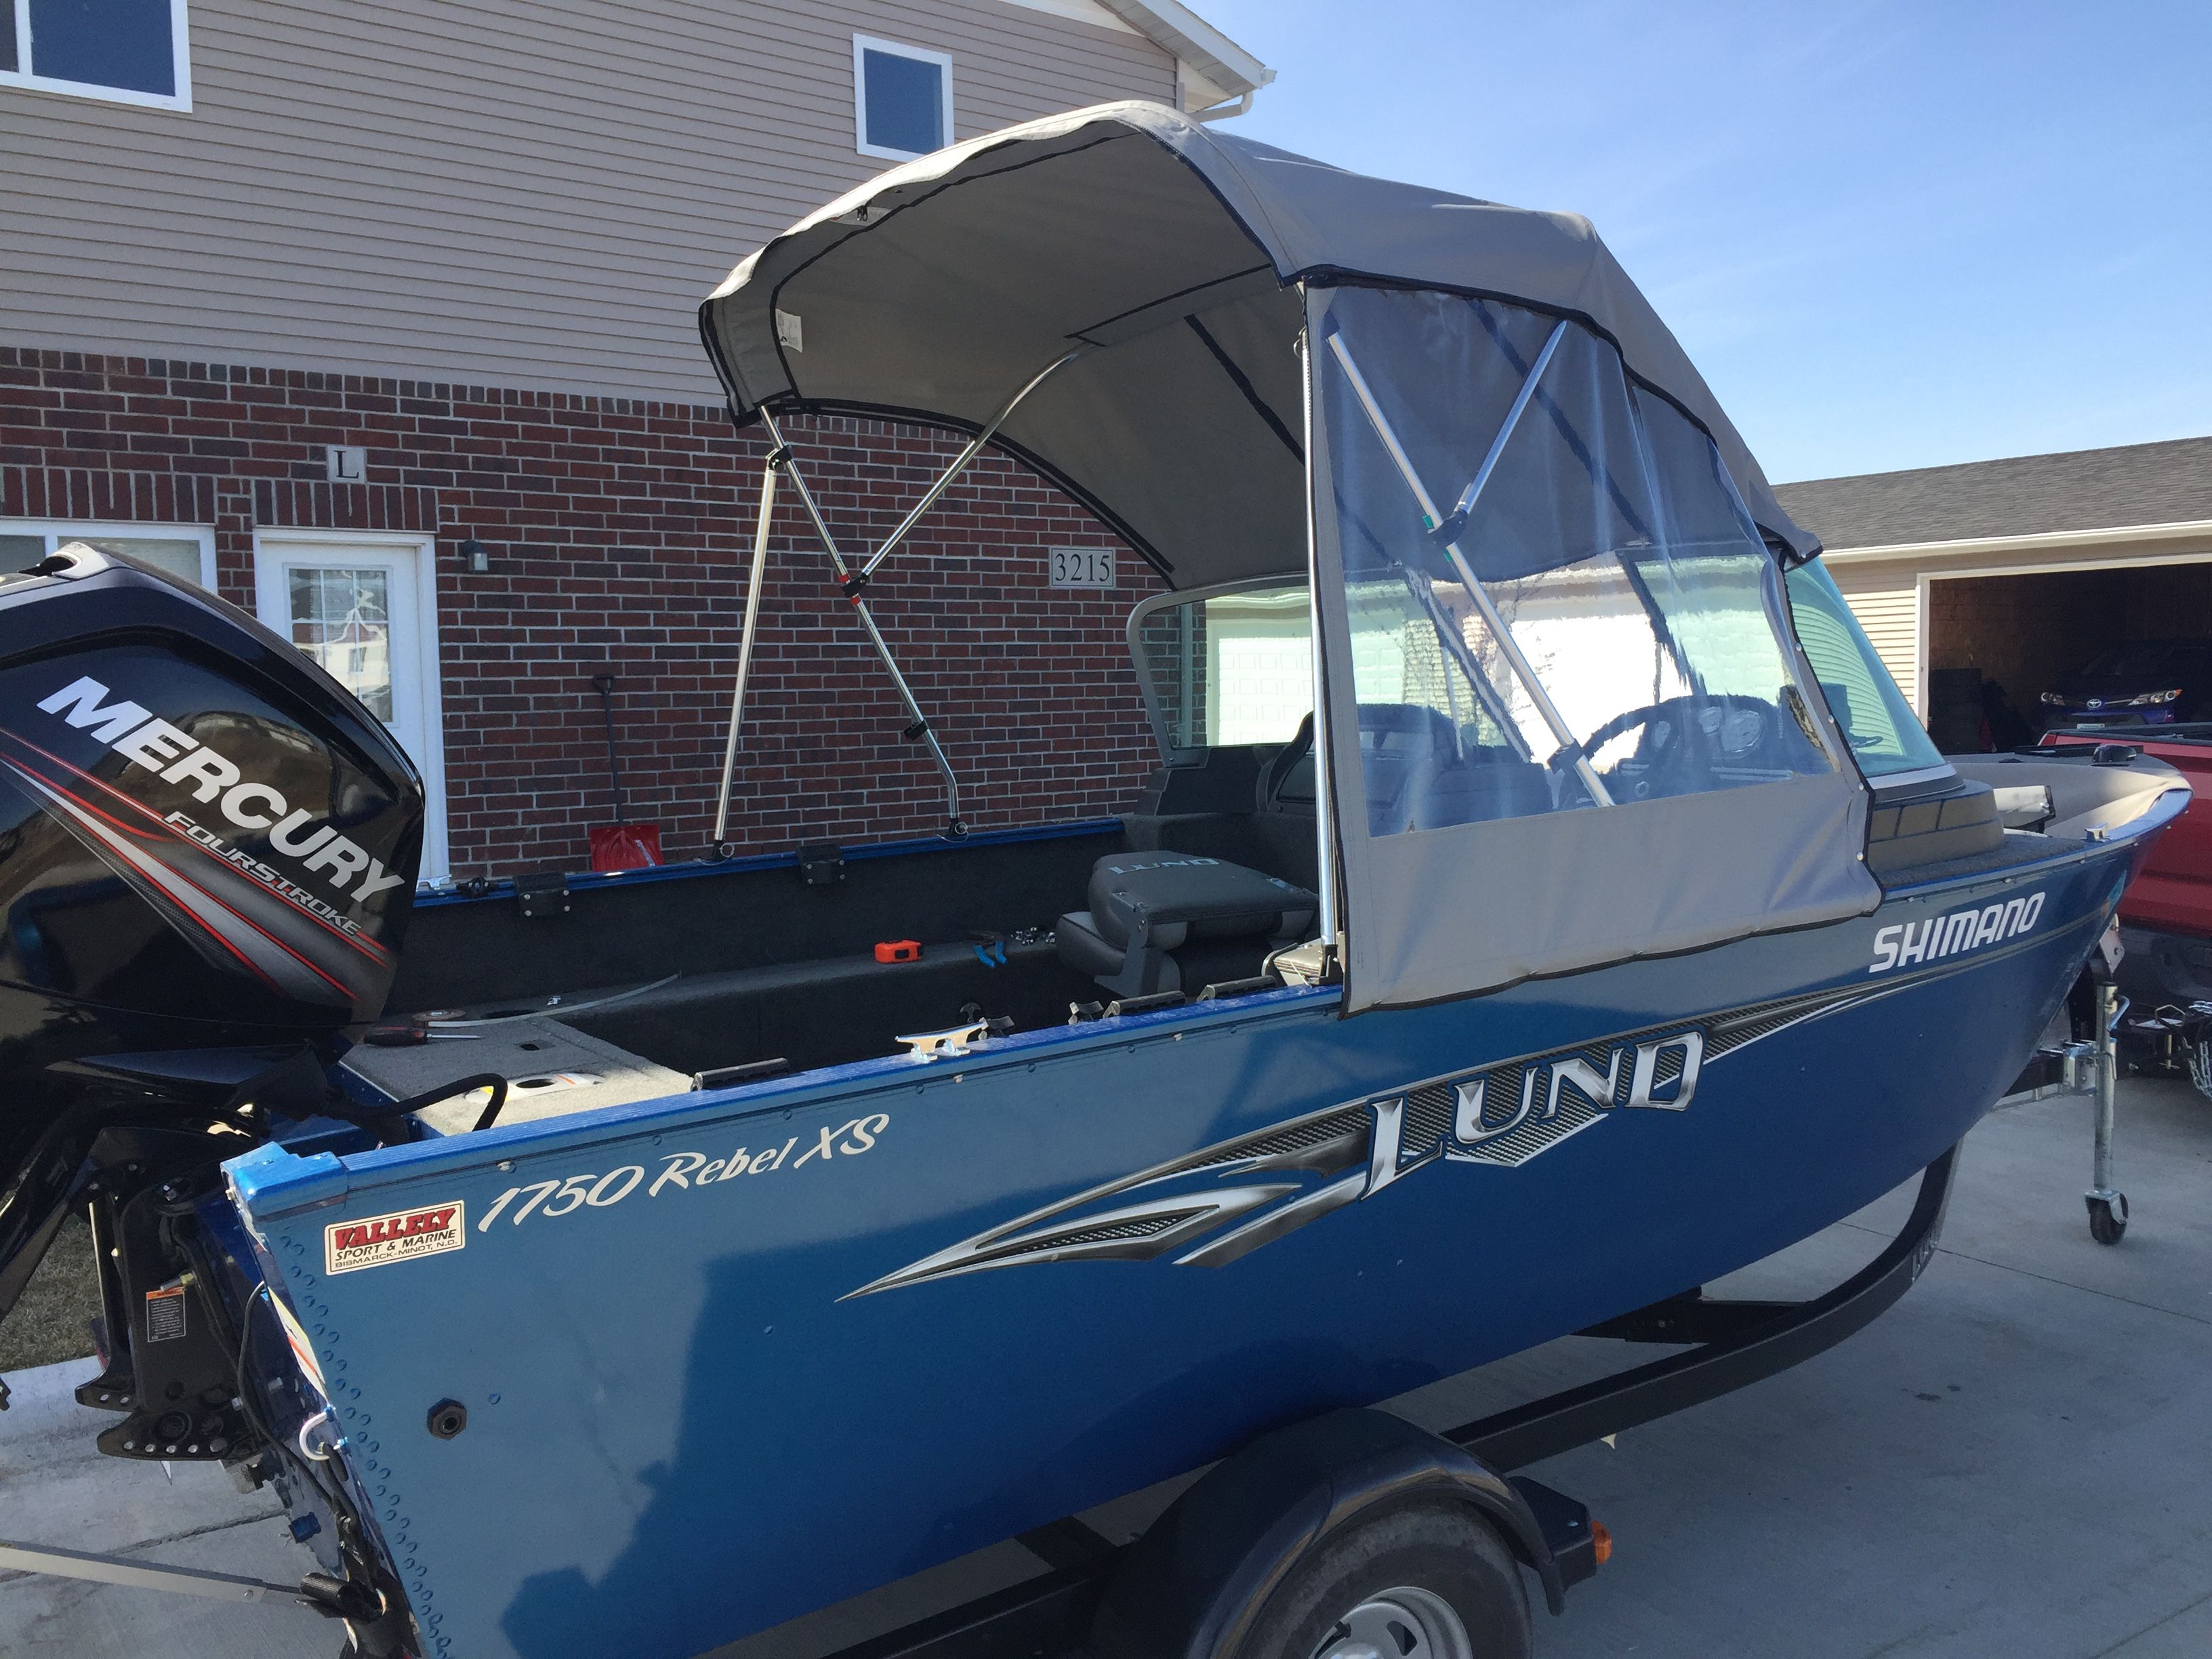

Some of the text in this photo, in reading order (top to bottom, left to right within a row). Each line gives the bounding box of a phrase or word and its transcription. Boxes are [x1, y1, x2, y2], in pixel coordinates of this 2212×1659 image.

[333, 450, 359, 478] L
[1055, 553, 1110, 582] 3215
[37, 676, 405, 903] MERCURY
[163, 811, 362, 935] FOURSTROKE
[1107, 858, 1219, 874] LUND
[1868, 891, 2046, 973] SHIMANO
[1359, 1029, 1706, 1202] LUND
[478, 1113, 890, 1232] 1750 Rebel XS
[335, 1208, 457, 1250] VALLELY
[335, 1229, 457, 1261] SPORT & MARINE
[335, 1239, 458, 1268] BISMARCK-MINOT, N.D.
